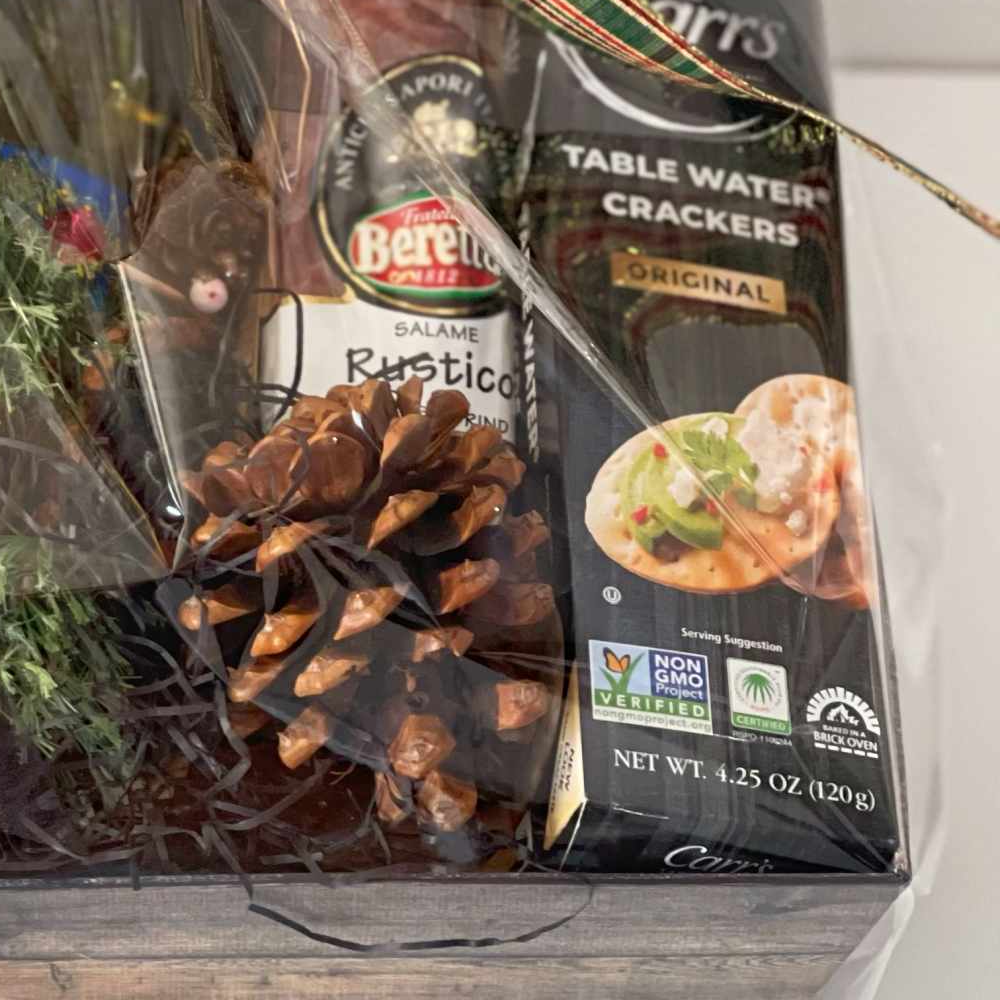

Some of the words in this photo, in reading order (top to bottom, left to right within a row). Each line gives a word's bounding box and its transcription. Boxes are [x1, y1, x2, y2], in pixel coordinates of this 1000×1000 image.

[562, 144, 680, 183] TABLE
[602, 192, 800, 247] CRACKERS
[626, 262, 771, 304] ORIGINAL
[394, 321, 479, 344] SALAME
[346, 347, 516, 400] Rustico
[681, 627, 722, 645] Serving
[724, 634, 783, 653] Suggestion
[653, 654, 702, 674] NON
[654, 669, 704, 689] GMO
[655, 683, 704, 700] Project
[600, 691, 705, 717] VERIFIED
[813, 730, 846, 746] BRICK
[847, 737, 878, 753] OVEN
[614, 749, 660, 773] NET
[666, 756, 707, 780] WT.
[715, 763, 762, 789] 4.25
[769, 773, 803, 796] OZ
